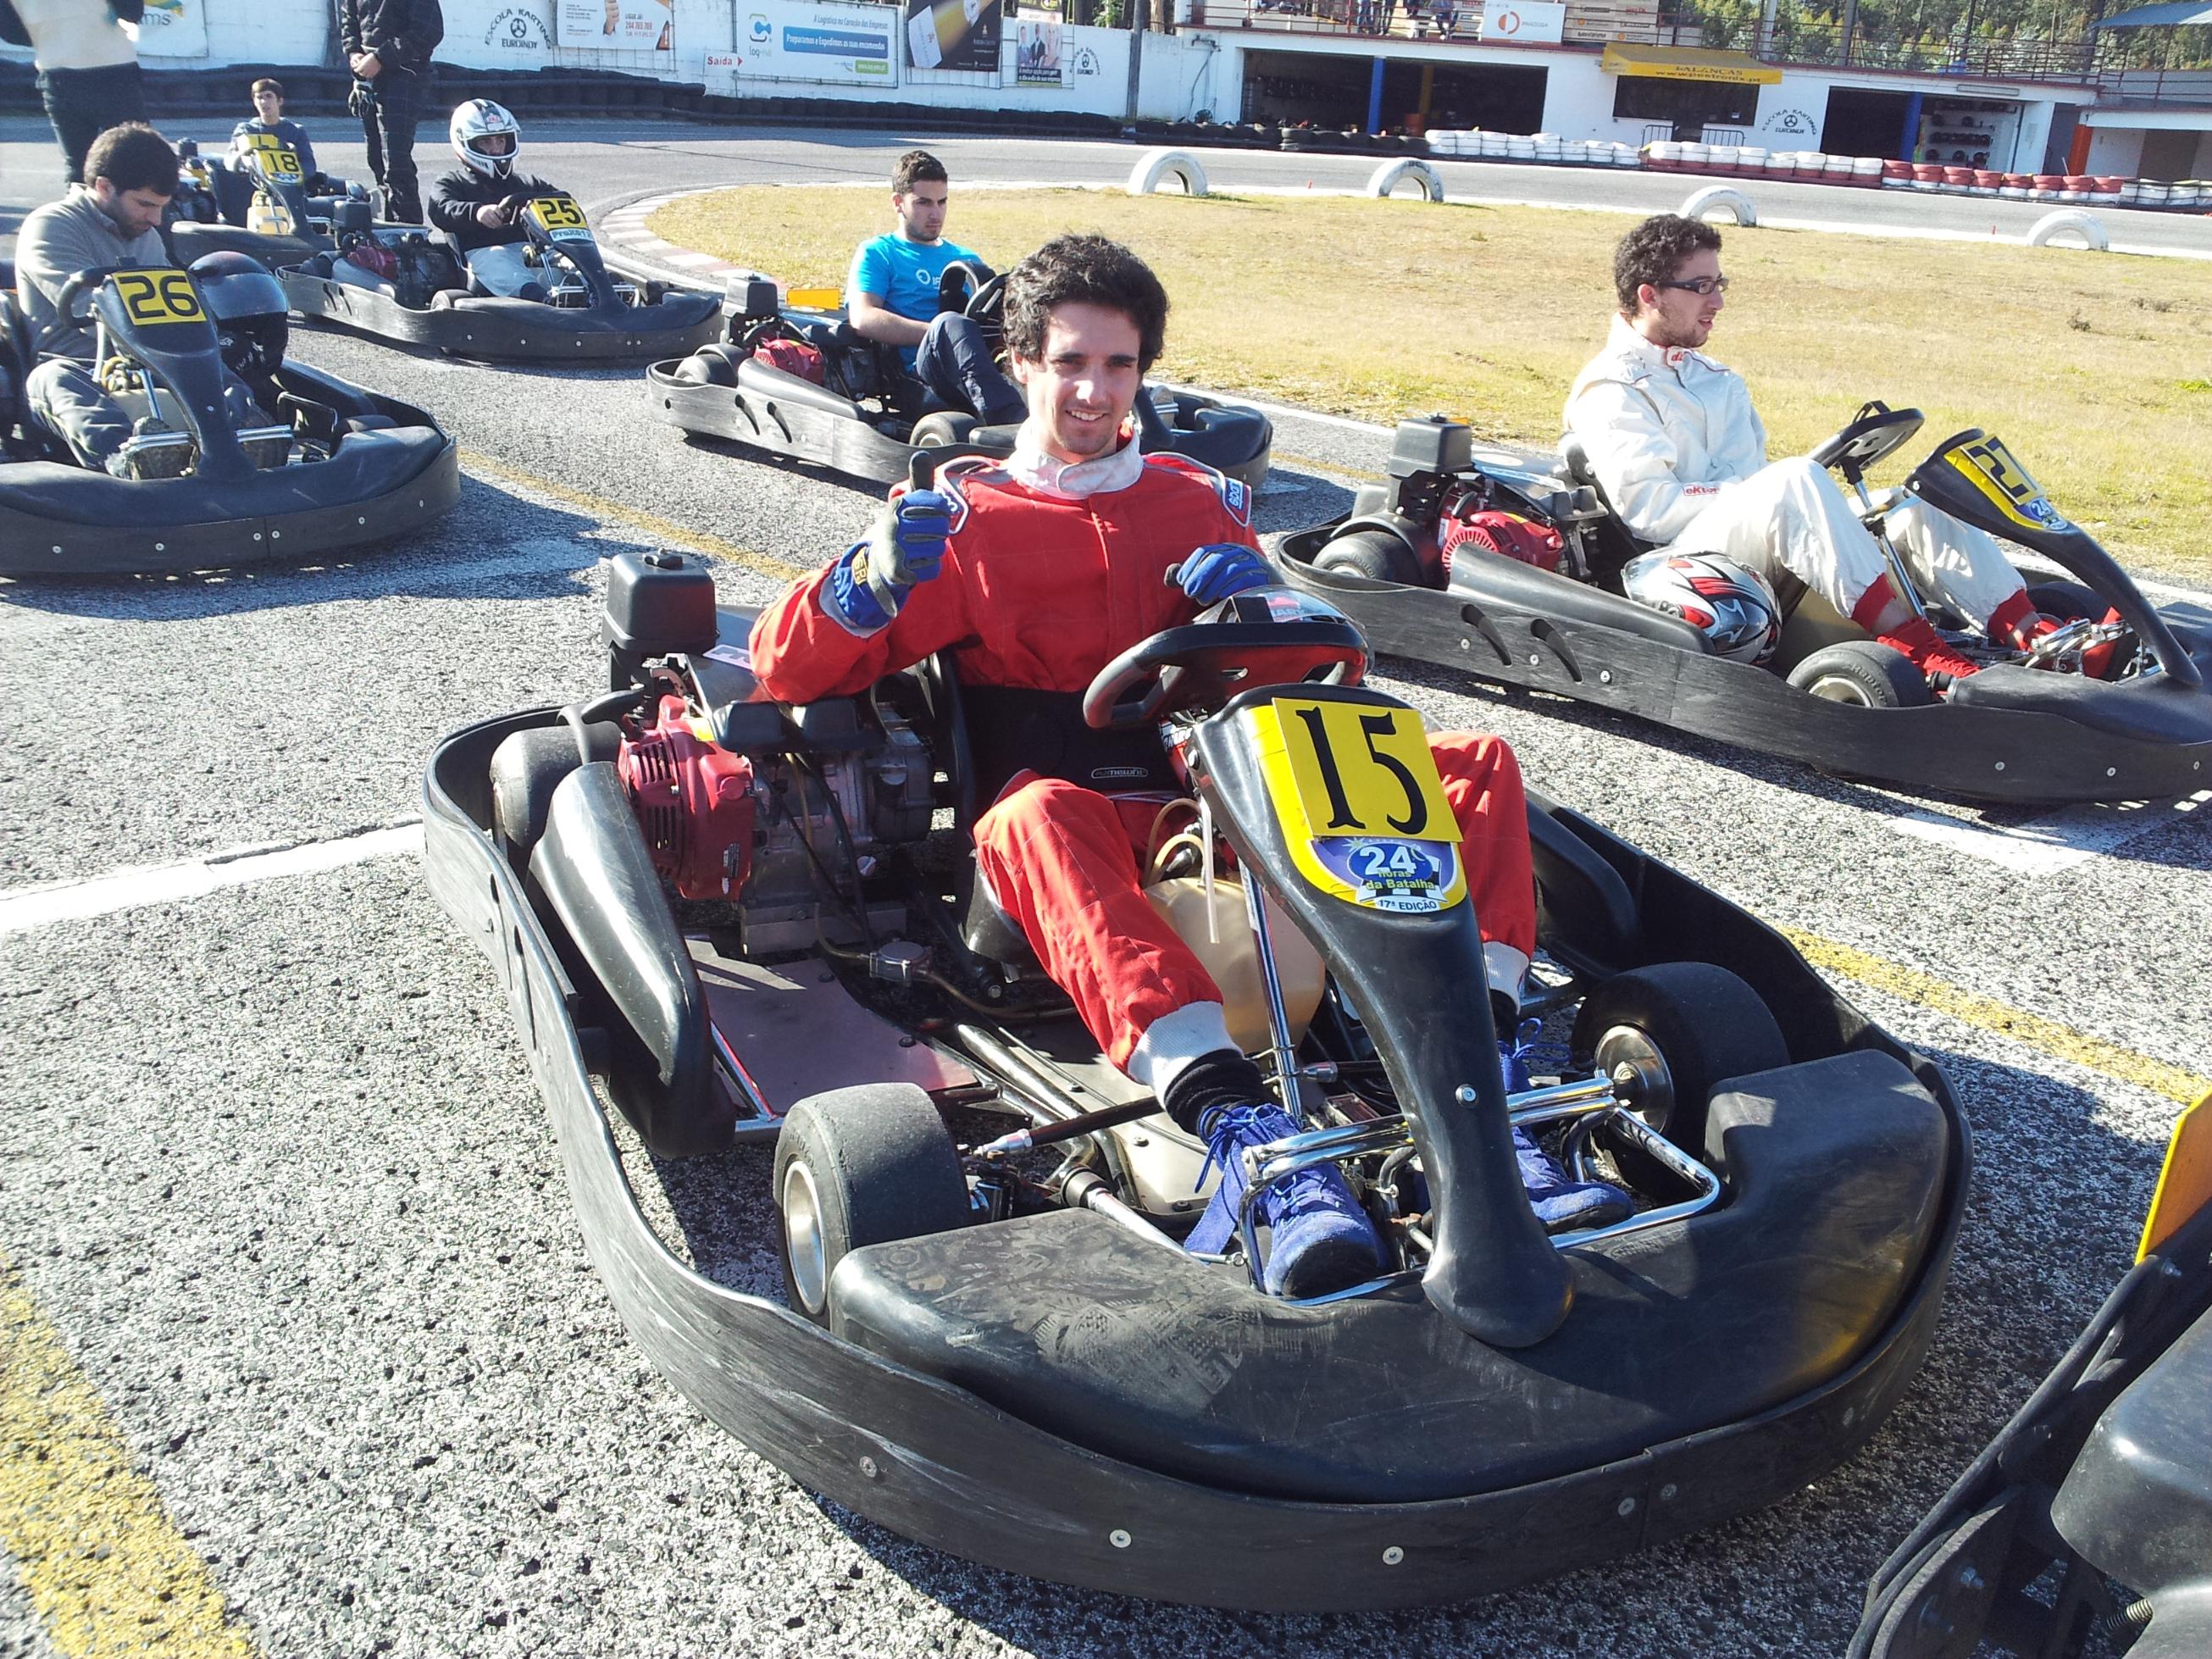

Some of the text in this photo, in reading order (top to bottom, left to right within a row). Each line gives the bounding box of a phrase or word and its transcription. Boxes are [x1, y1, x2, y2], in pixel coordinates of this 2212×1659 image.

[485, 8, 513, 46] ESCOLA
[518, 8, 551, 50] KARTING
[707, 56, 733, 66] Saída
[267, 153, 300, 172] 18
[537, 200, 581, 225] 25
[118, 275, 200, 319] 26
[1295, 706, 1428, 835] 15
[1359, 846, 1416, 875] 24
[1378, 868, 1412, 878] horas
[1366, 879, 1436, 891] da Batalha
[1379, 899, 1438, 912] 17ª EDIÇÃO
